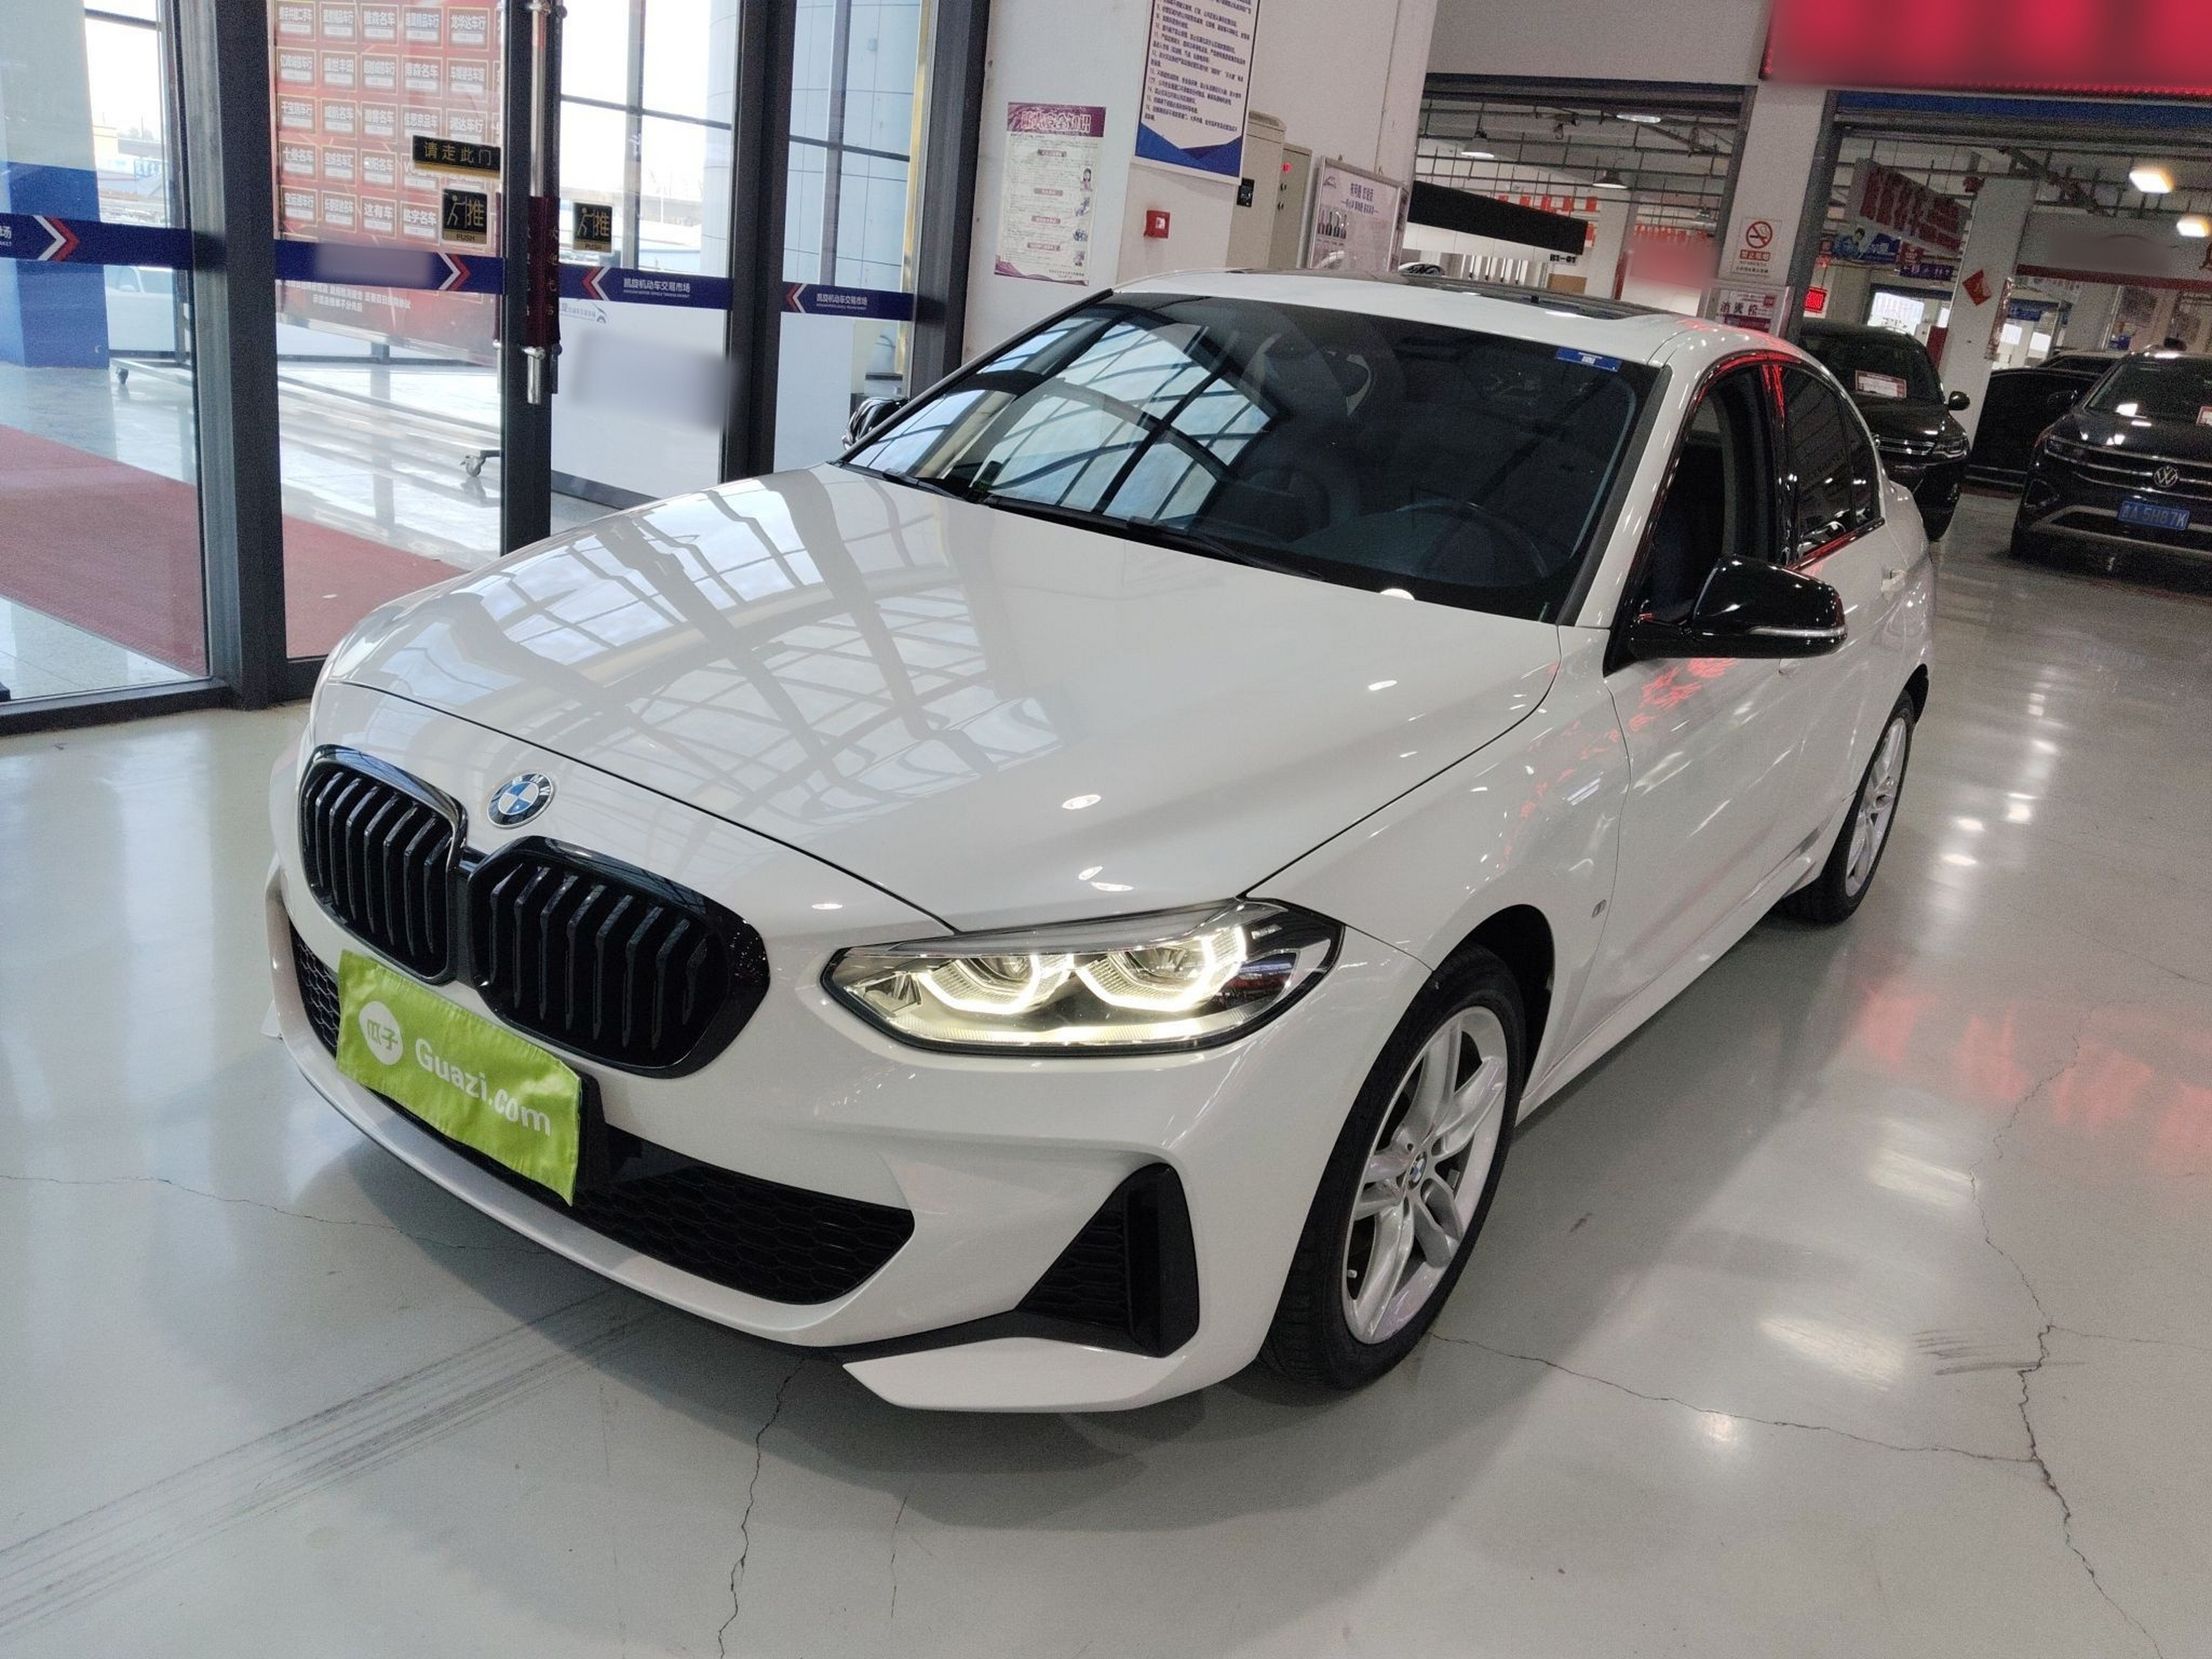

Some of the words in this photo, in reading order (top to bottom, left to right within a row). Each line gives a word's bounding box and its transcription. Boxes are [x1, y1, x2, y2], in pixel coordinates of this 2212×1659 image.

[424, 141, 491, 166] 请走此门
[467, 199, 484, 226] 推
[594, 211, 610, 236] 推
[456, 233, 475, 242] PUSH
